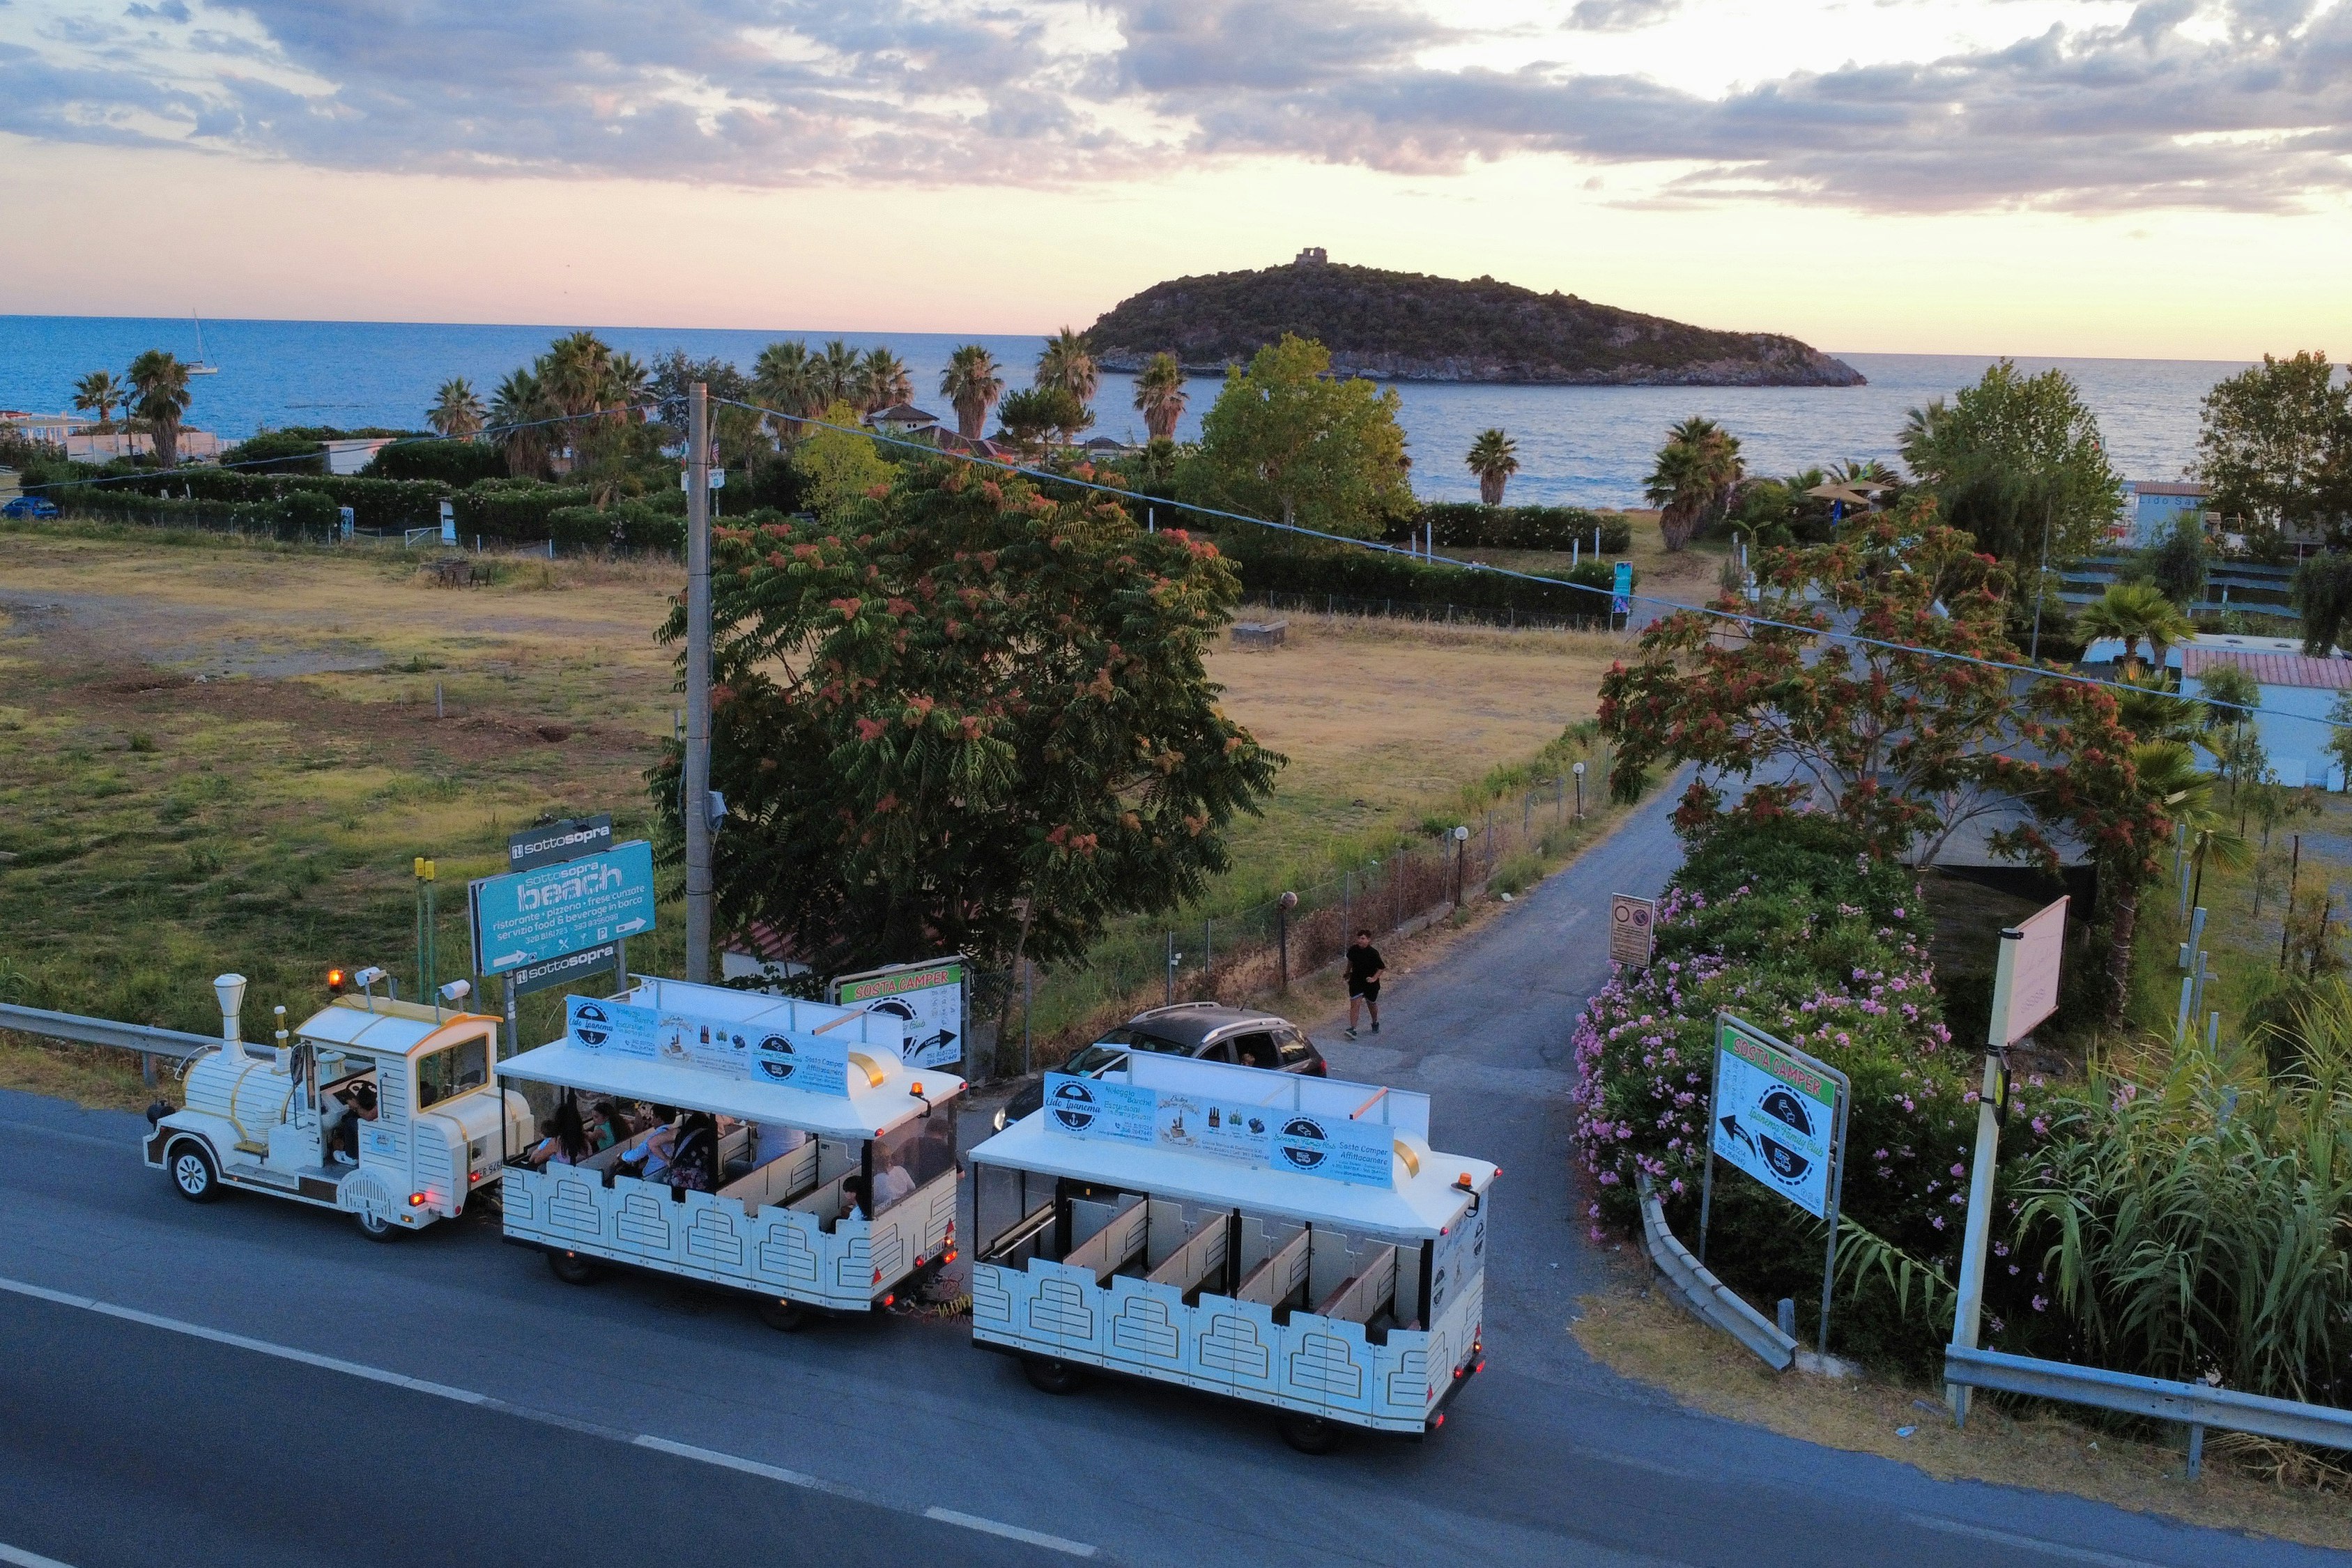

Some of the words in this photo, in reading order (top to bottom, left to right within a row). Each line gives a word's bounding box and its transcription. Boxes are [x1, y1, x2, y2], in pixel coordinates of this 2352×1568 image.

[2139, 495, 2169, 505] Lido
[524, 826, 610, 855] sottosopra
[525, 862, 599, 887] sottosopra
[517, 863, 623, 913] beach
[493, 913, 541, 931] ristorante
[546, 902, 582, 919] pizzeria
[587, 894, 610, 907] frese
[497, 925, 533, 941] servizio
[535, 918, 555, 932] food
[558, 916, 565, 925] &
[565, 907, 608, 923] beverage
[608, 900, 617, 912] in
[617, 896, 643, 909] barca
[528, 946, 615, 980] sottosopra
[855, 981, 896, 999] SOSTA
[899, 971, 948, 991] CAMPER
[569, 1018, 582, 1027] Lido
[585, 1021, 613, 1032] Ipanema
[909, 1020, 925, 1030] Club
[805, 1055, 821, 1064] Sosta
[822, 1058, 843, 1068] Camper
[1733, 1037, 1770, 1069] SOSTA
[1773, 1058, 1822, 1097] CAMPER
[1105, 1086, 1135, 1097] Noleggio
[1046, 1097, 1062, 1107] Lido
[1066, 1100, 1102, 1114] Ipanema
[1105, 1100, 1140, 1114] Escursioni
[1127, 1098, 1152, 1107] Barche
[1748, 1106, 1781, 1130] Ipanema
[1781, 1123, 1806, 1150] Family
[1806, 1140, 1824, 1158] Club
[1339, 1142, 1359, 1151] Sosta
[1360, 1145, 1388, 1156] Camper
[1340, 1151, 1388, 1166] Affittacamere
